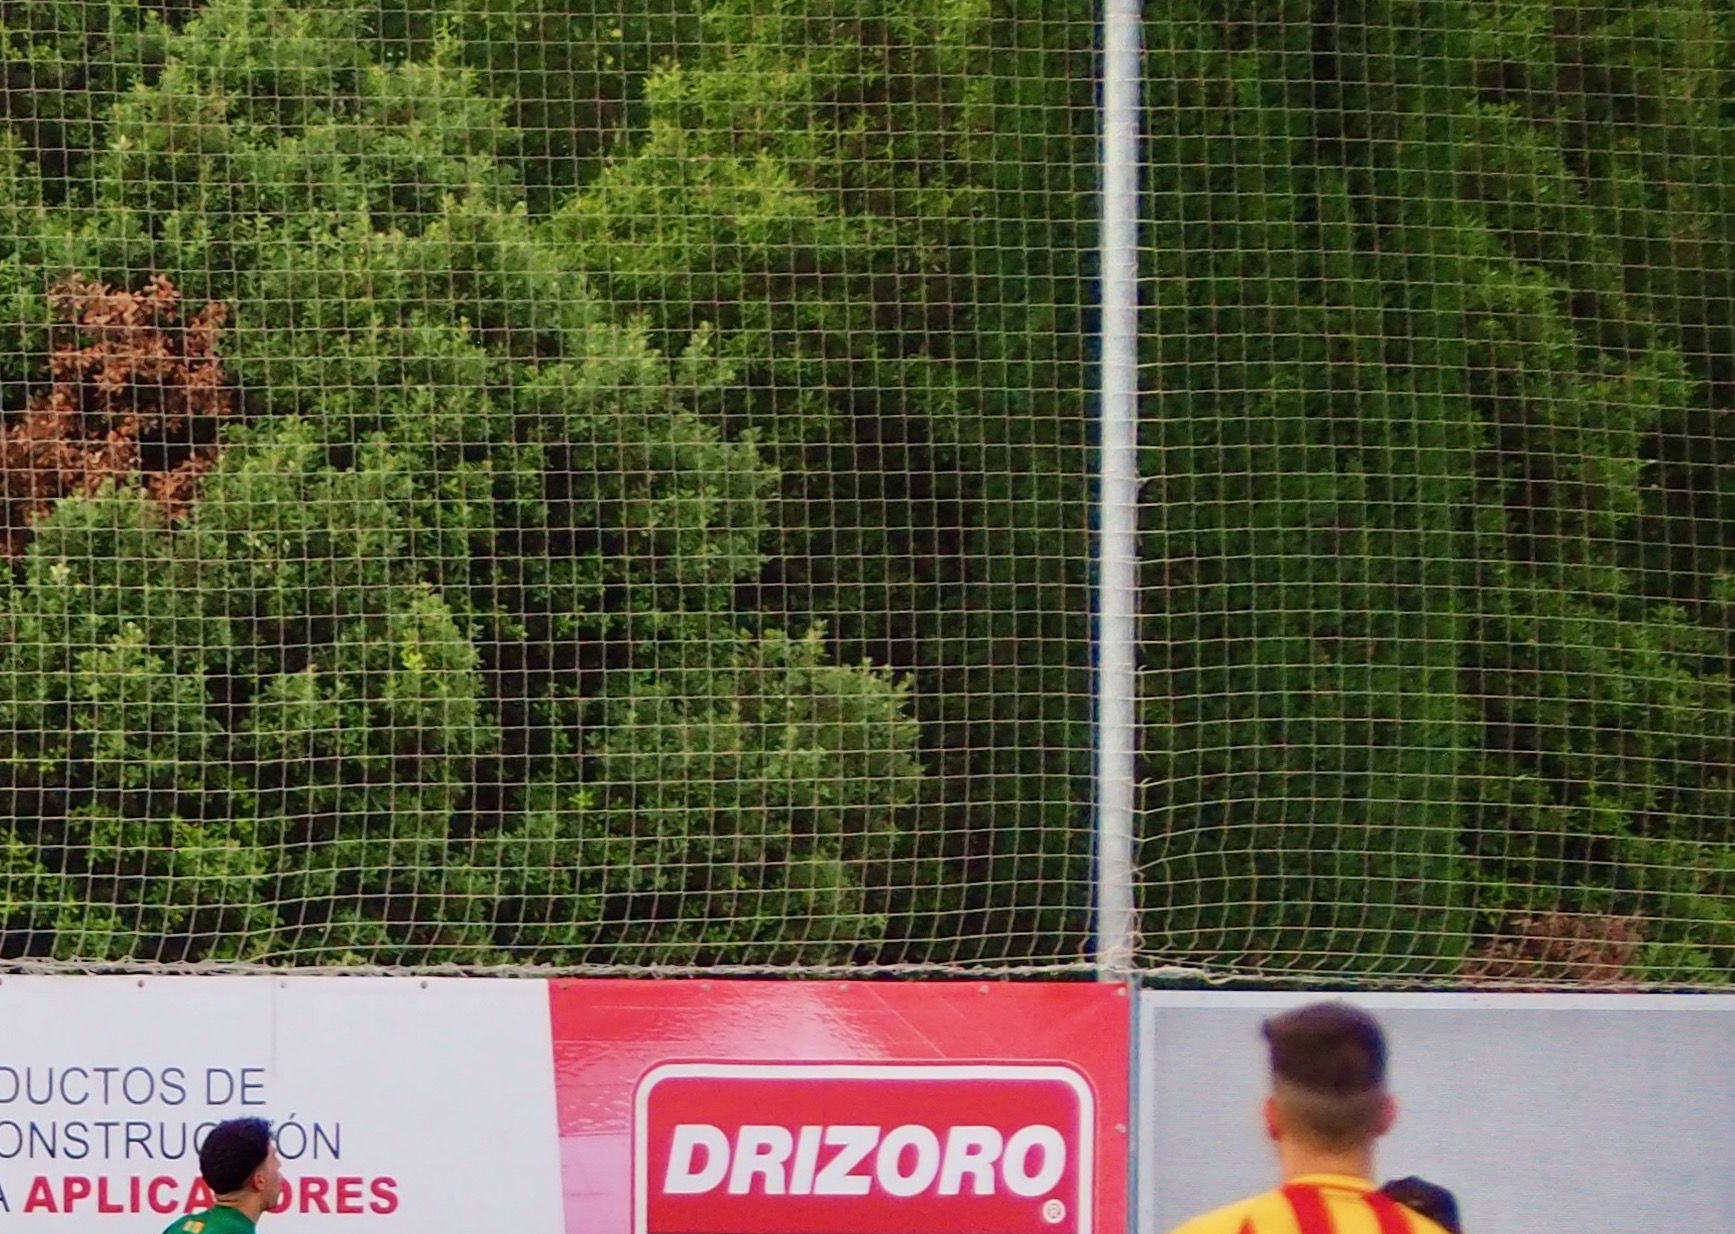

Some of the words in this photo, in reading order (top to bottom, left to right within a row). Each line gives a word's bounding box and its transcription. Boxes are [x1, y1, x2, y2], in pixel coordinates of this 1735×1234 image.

[206, 1067, 266, 1106] DE
[664, 1124, 1066, 1197] DRIZORO
[24, 1175, 400, 1215] APLICARES
